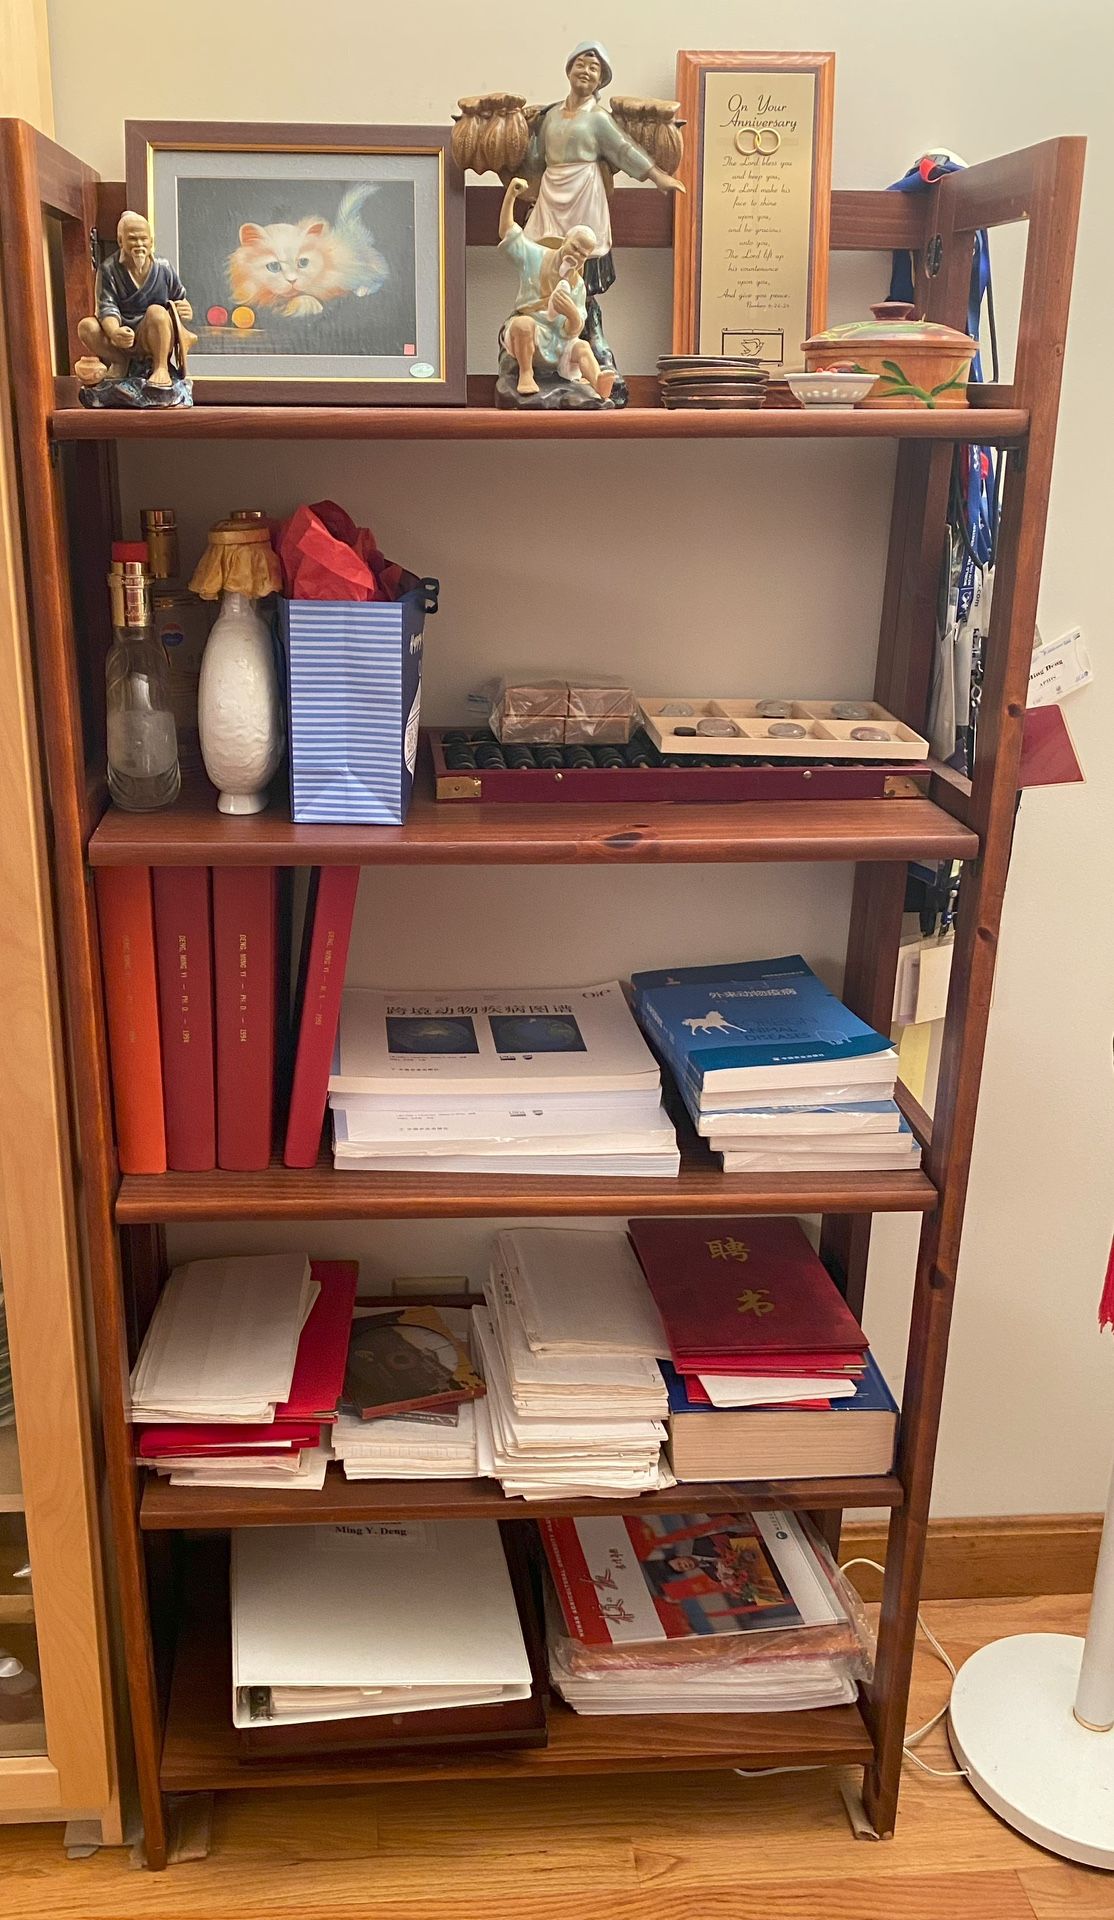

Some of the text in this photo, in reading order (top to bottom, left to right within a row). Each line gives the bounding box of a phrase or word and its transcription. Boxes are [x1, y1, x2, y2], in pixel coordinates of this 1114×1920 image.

[727, 93, 787, 115] On Your
[720, 109, 797, 132] Anniversary
[722, 155, 792, 168] The Lord bless you
[732, 170, 746, 180] and
[748, 170, 763, 181] keep
[721, 182, 791, 193] The Lord make his
[733, 196, 747, 208] face
[760, 197, 777, 206] shine
[738, 214, 754, 222] upon
[728, 223, 781, 235] and be gracious
[723, 248, 738, 259] The
[741, 248, 761, 259] Lord
[763, 248, 773, 261] lift
[728, 262, 738, 272] his
[717, 288, 737, 298] And
[239, 934, 247, 951] DENG,
[180, 954, 188, 970] MING
[239, 953, 247, 969] MING
[239, 1029, 247, 1042] 1994
[335, 1526, 408, 1536] Ming Y. Deng
